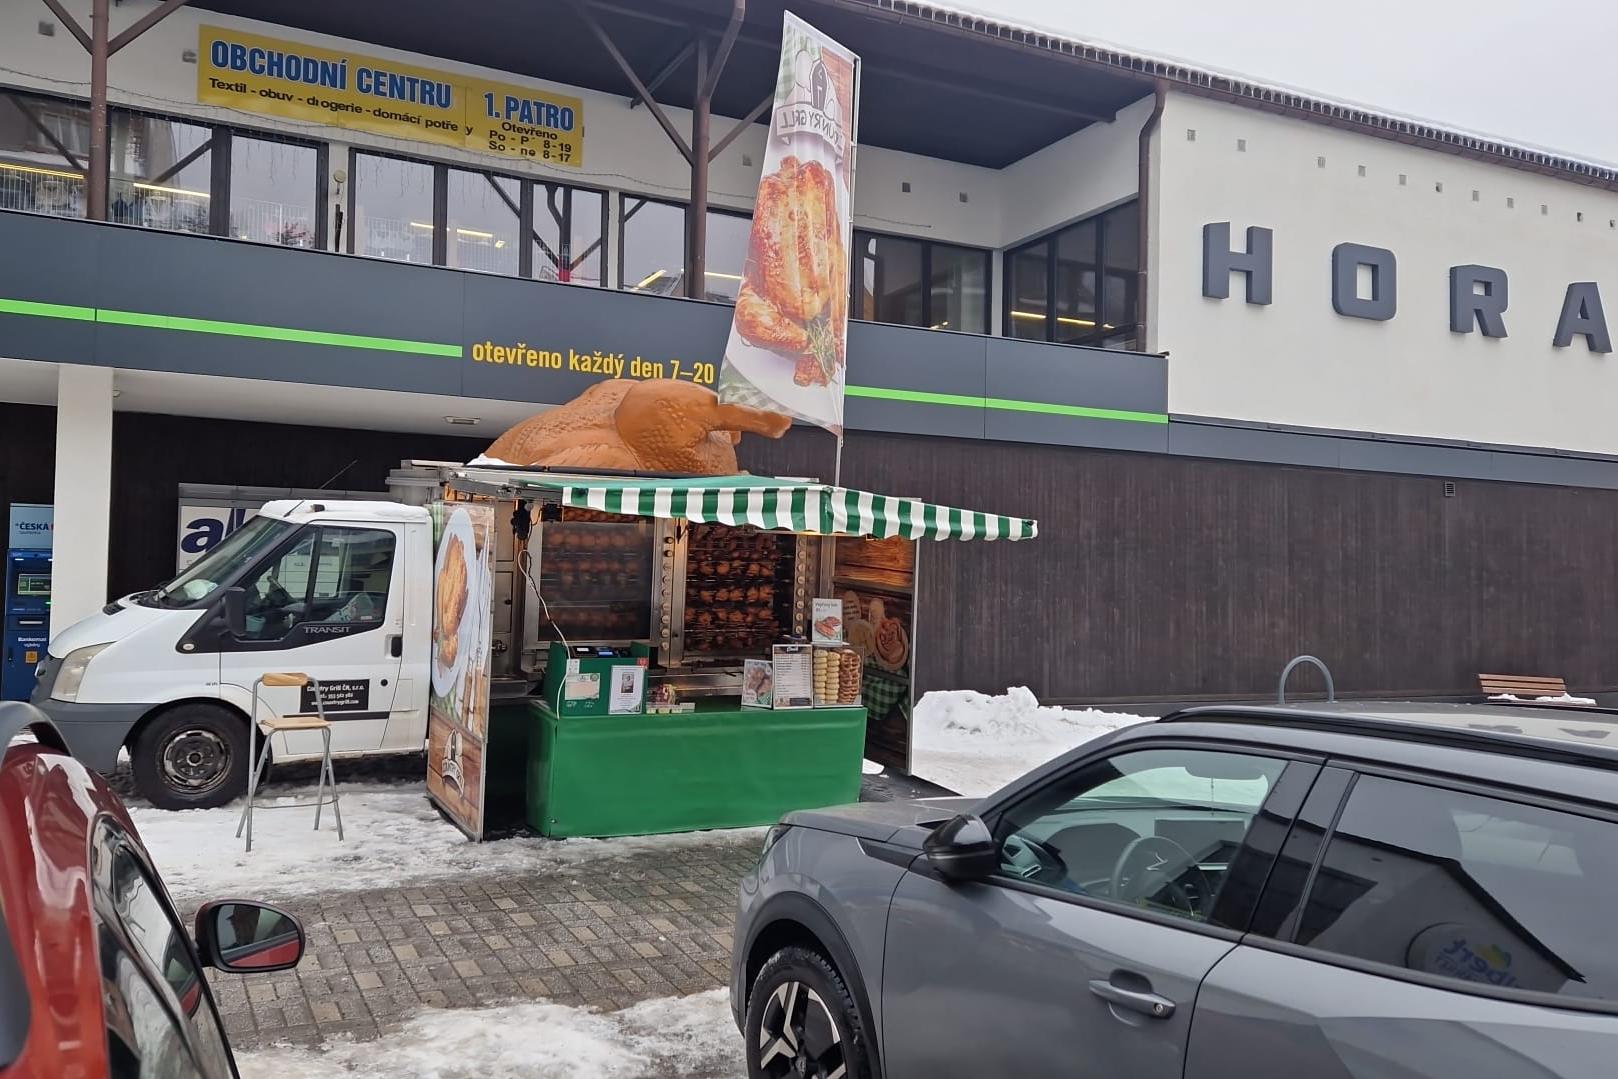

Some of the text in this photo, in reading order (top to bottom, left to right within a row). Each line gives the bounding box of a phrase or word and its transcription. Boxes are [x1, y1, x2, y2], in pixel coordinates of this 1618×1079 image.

[210, 40, 452, 109] OBCHODNÍ CENTRU
[209, 77, 247, 94] Textil
[259, 88, 294, 102] obuv
[484, 92, 574, 132] 1. PATRO
[489, 129, 506, 141] Po
[501, 121, 558, 140] Otevřeno
[488, 140, 506, 152] So
[472, 340, 562, 370] otevřeno
[568, 348, 625, 380] každý
[630, 356, 663, 380] den
[303, 626, 351, 634] TRANSIT
